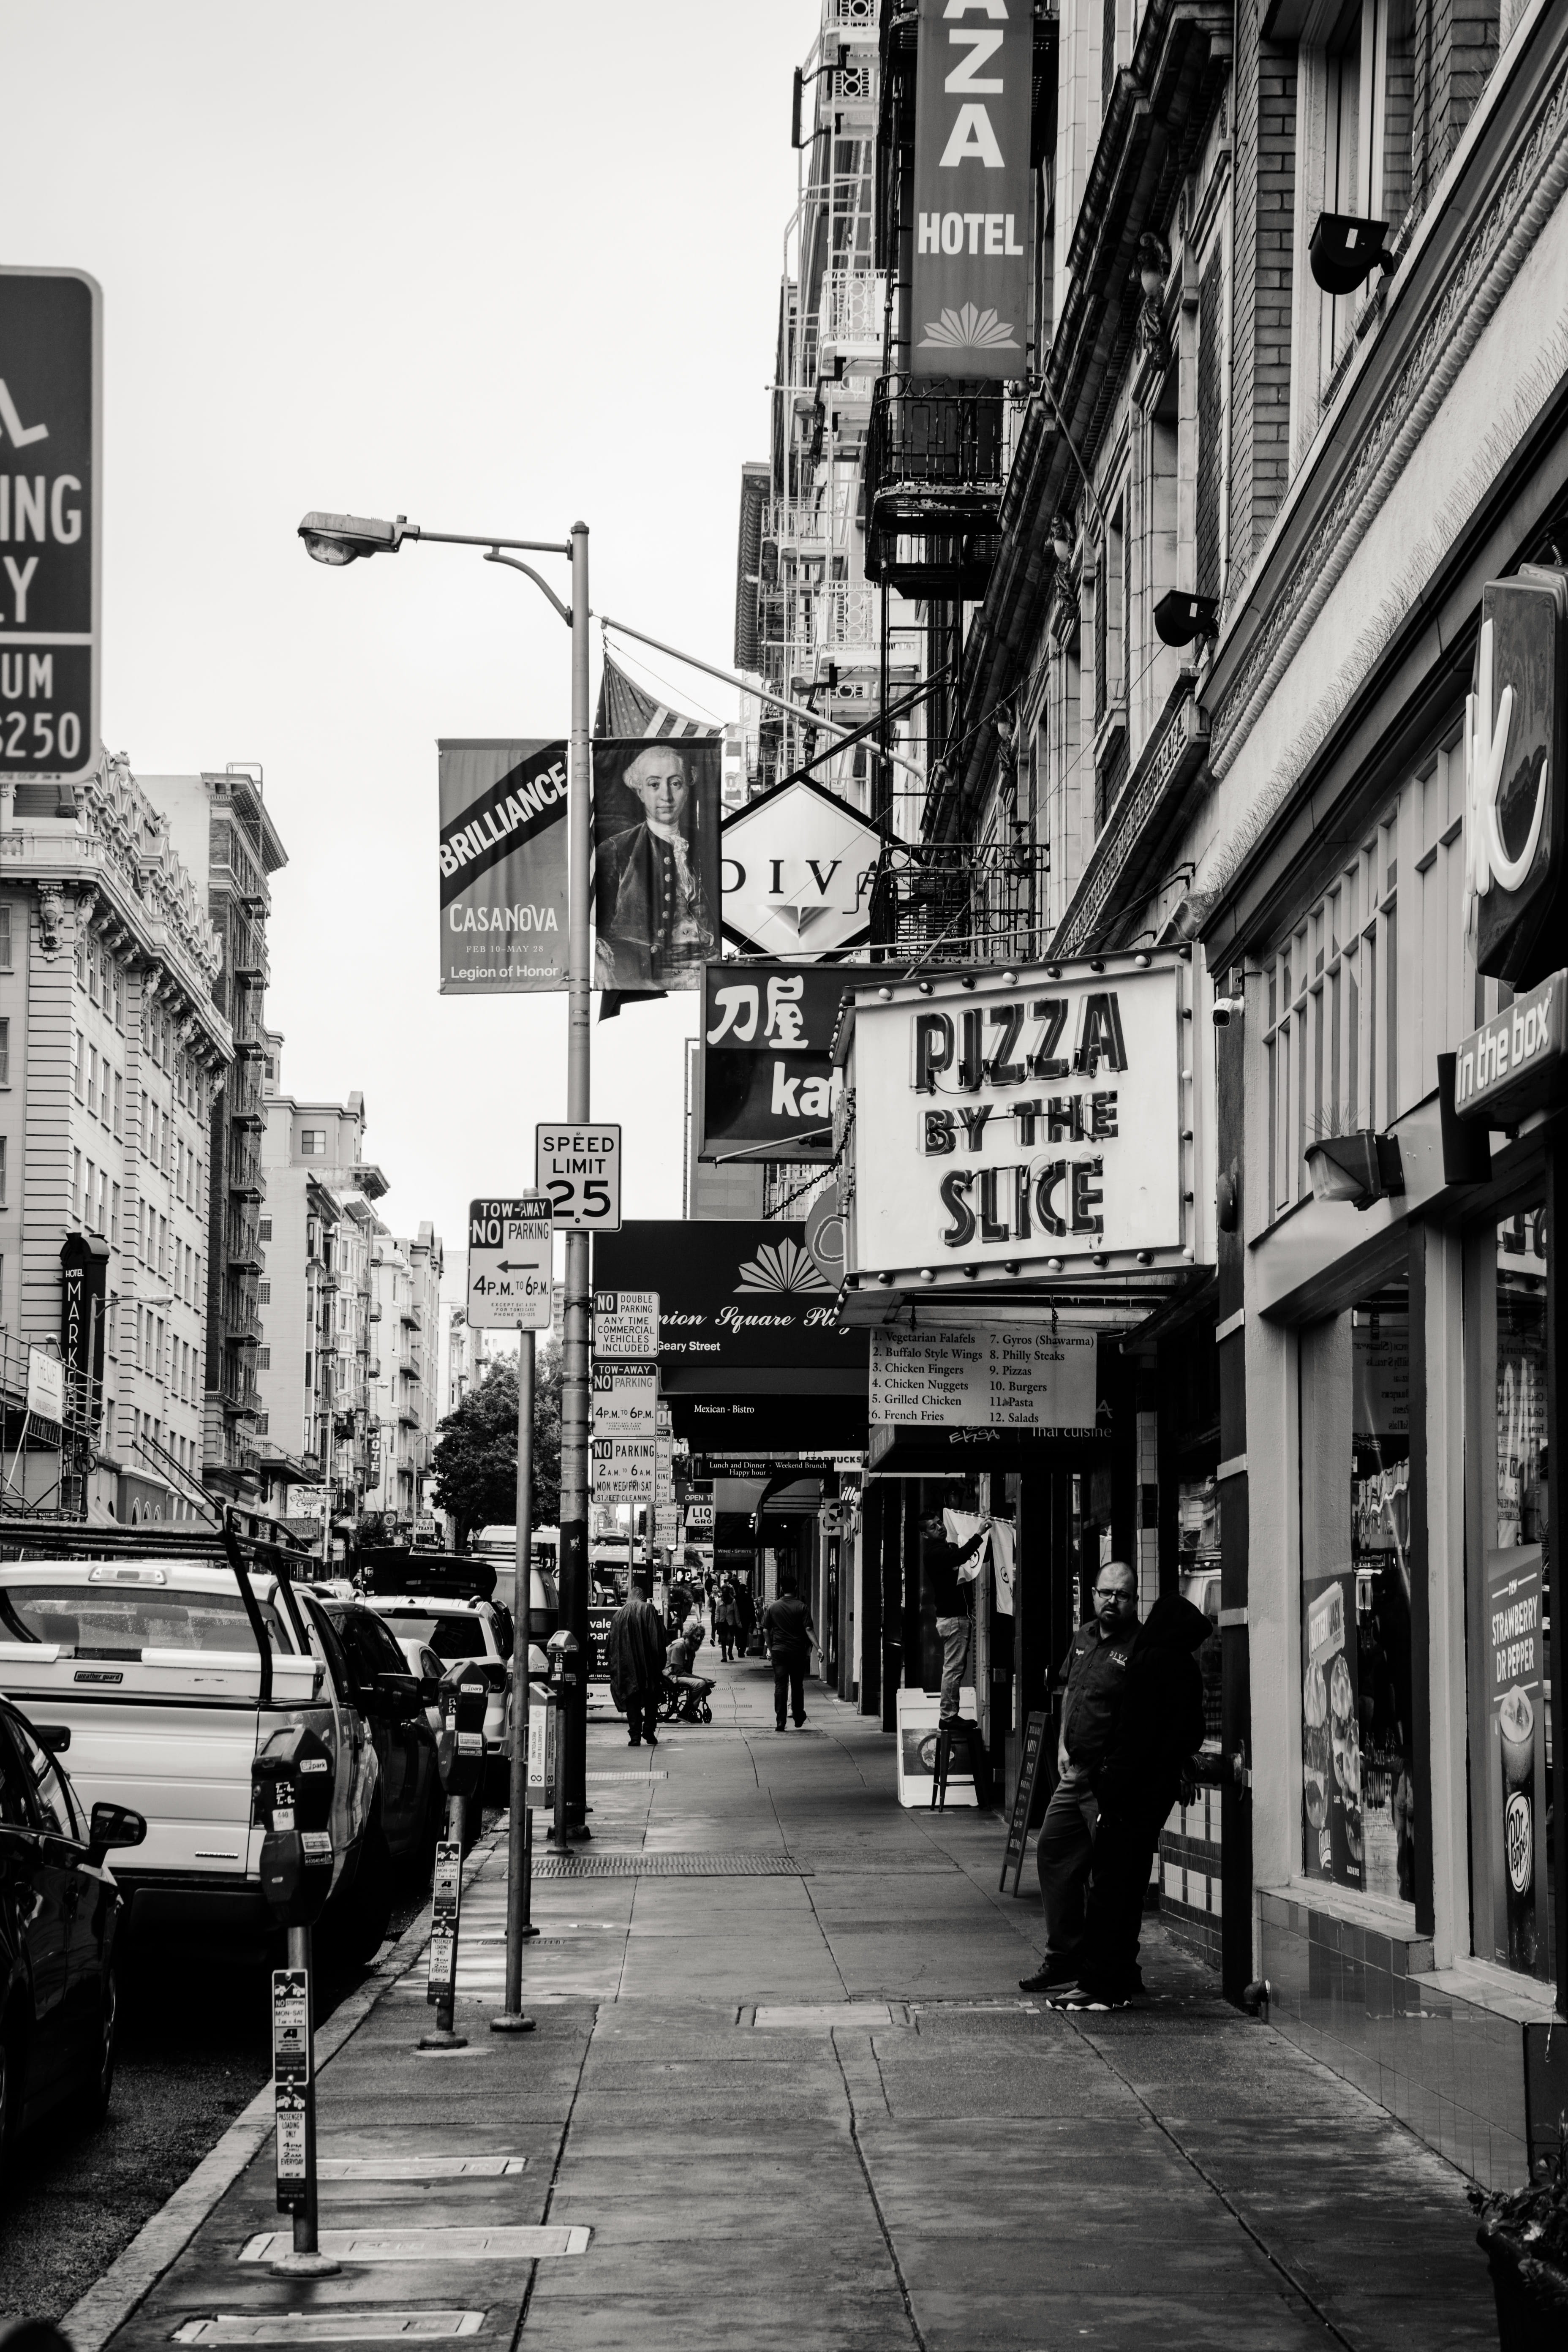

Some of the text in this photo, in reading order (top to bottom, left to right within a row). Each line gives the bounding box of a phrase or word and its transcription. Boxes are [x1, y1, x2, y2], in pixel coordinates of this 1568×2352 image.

[918, 212, 1024, 255] HOTEL
[0, 555, 40, 623] Y
[1, 653, 53, 699] UM
[0, 711, 81, 759] 250
[439, 761, 568, 878] BRILLIANCE
[449, 903, 559, 932] CASANOVA
[451, 966, 558, 982] Legion of Honor
[909, 991, 1128, 1094] PIZZA
[1457, 997, 1549, 1104] in the box
[917, 1090, 1119, 1157] BY THE
[543, 1137, 615, 1152] SPEED
[553, 1158, 606, 1174] LIMIT
[546, 1180, 611, 1217] 25
[938, 1157, 1104, 1247] SLICE
[481, 1202, 546, 1217] TOW-AWAY
[472, 1220, 549, 1244] NO PARKING
[65, 1269, 84, 1278] HOTEL
[516, 1281, 524, 1290] TO
[597, 1295, 653, 1311] NO DOUBLE
[621, 1305, 653, 1314] PARKING
[604, 1317, 649, 1325] ANY TIME
[715, 1306, 796, 1334] Square
[597, 1326, 655, 1334] COMMERCIAL
[604, 1335, 649, 1343] VEHICLES
[874, 1331, 975, 1344] 1. Vegetarian Falafels
[991, 1334, 1094, 1348] 7. Gyros (Shawarma)
[602, 1344, 650, 1352] INCLUDED
[659, 1342, 721, 1352] Geary Street
[872, 1347, 983, 1362] 2. Buffalo Style Wings
[990, 1350, 1065, 1363] 8. Philly Steaks
[599, 1366, 650, 1374] TOW-AWAY
[872, 1362, 964, 1376] 3. Chicken Fingers
[989, 1365, 1032, 1376] 9. Pizzas
[594, 1375, 652, 1389] NO PARKING
[872, 1378, 968, 1393] 4. Chicken Nuggets
[990, 1381, 1047, 1394] 10. Burgers
[872, 1394, 961, 1406] 5. Grilled Chicken
[1009, 1397, 1033, 1407] Pasta
[694, 1405, 754, 1413] Mexican Bistro
[871, 1410, 944, 1421] 6. French Fries
[990, 1412, 1039, 1423] 12. Salads
[1064, 1427, 1112, 1437] cuisine
[594, 1442, 654, 1458] NO PARKING
[599, 1464, 606, 1476] 2
[631, 1464, 637, 1476] 6
[597, 1481, 611, 1492] MON
[613, 1481, 626, 1492] WED
[641, 1481, 652, 1492] SAT
[692, 1508, 711, 1519] LIQ
[1492, 1595, 1538, 1647] STRAWBERRY
[1497, 1637, 1534, 1683] DR PEPPER
[312, 1762, 326, 1770] park
